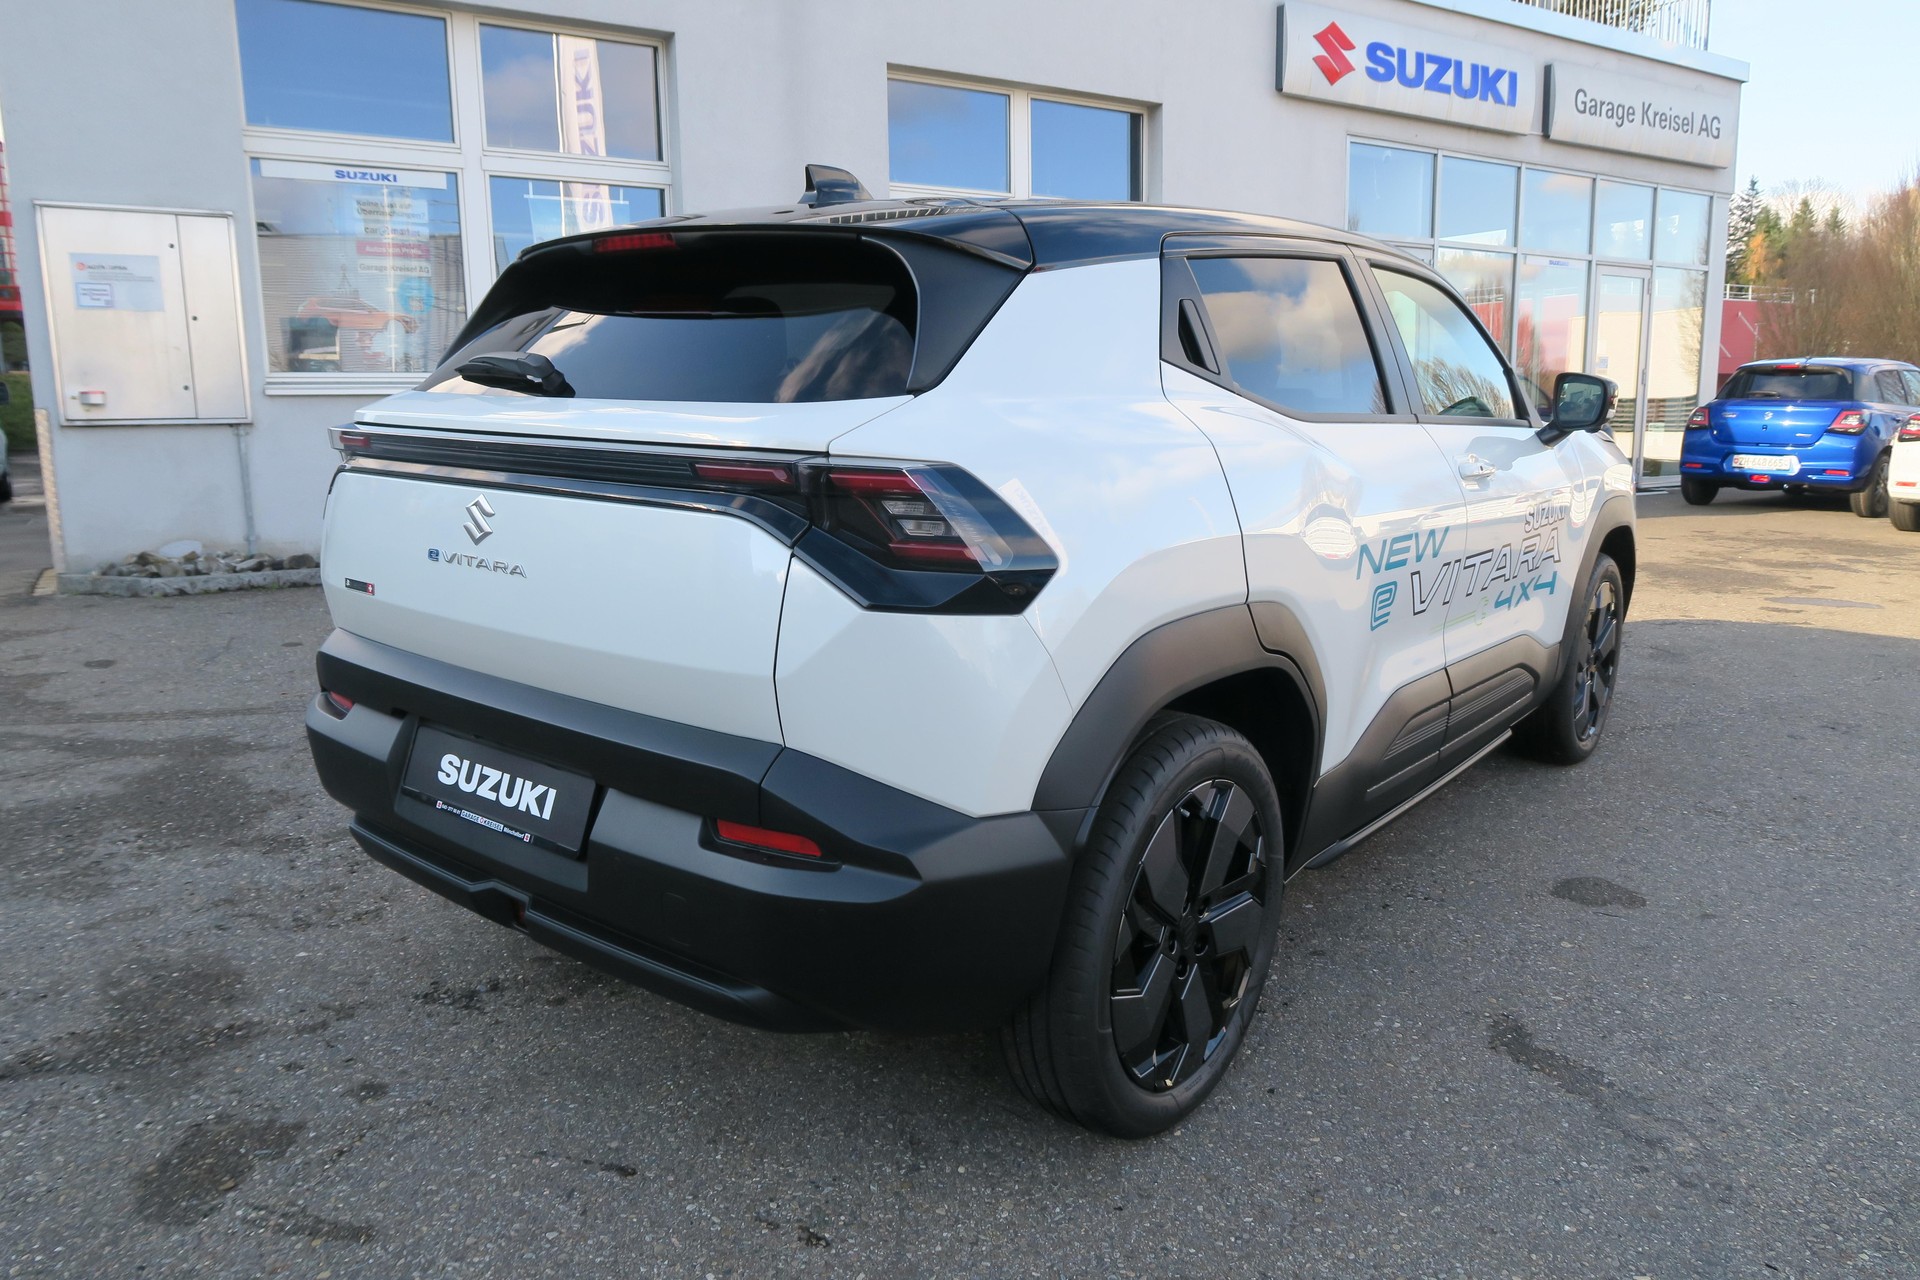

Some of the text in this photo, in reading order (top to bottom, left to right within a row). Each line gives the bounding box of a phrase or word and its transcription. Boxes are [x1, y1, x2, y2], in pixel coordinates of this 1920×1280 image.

[1365, 41, 1518, 107] SUZUKI
[573, 50, 607, 224] SZUKI
[1574, 88, 1721, 140] Garage Kreisel AG
[335, 169, 398, 183] SUZUKI
[1523, 498, 1566, 534] SUZUKI
[1356, 526, 1449, 580] NEW
[1410, 526, 1561, 616] VITARA
[437, 753, 557, 820] SUZUKI
[461, 810, 502, 831] GARAGE KREISEL
